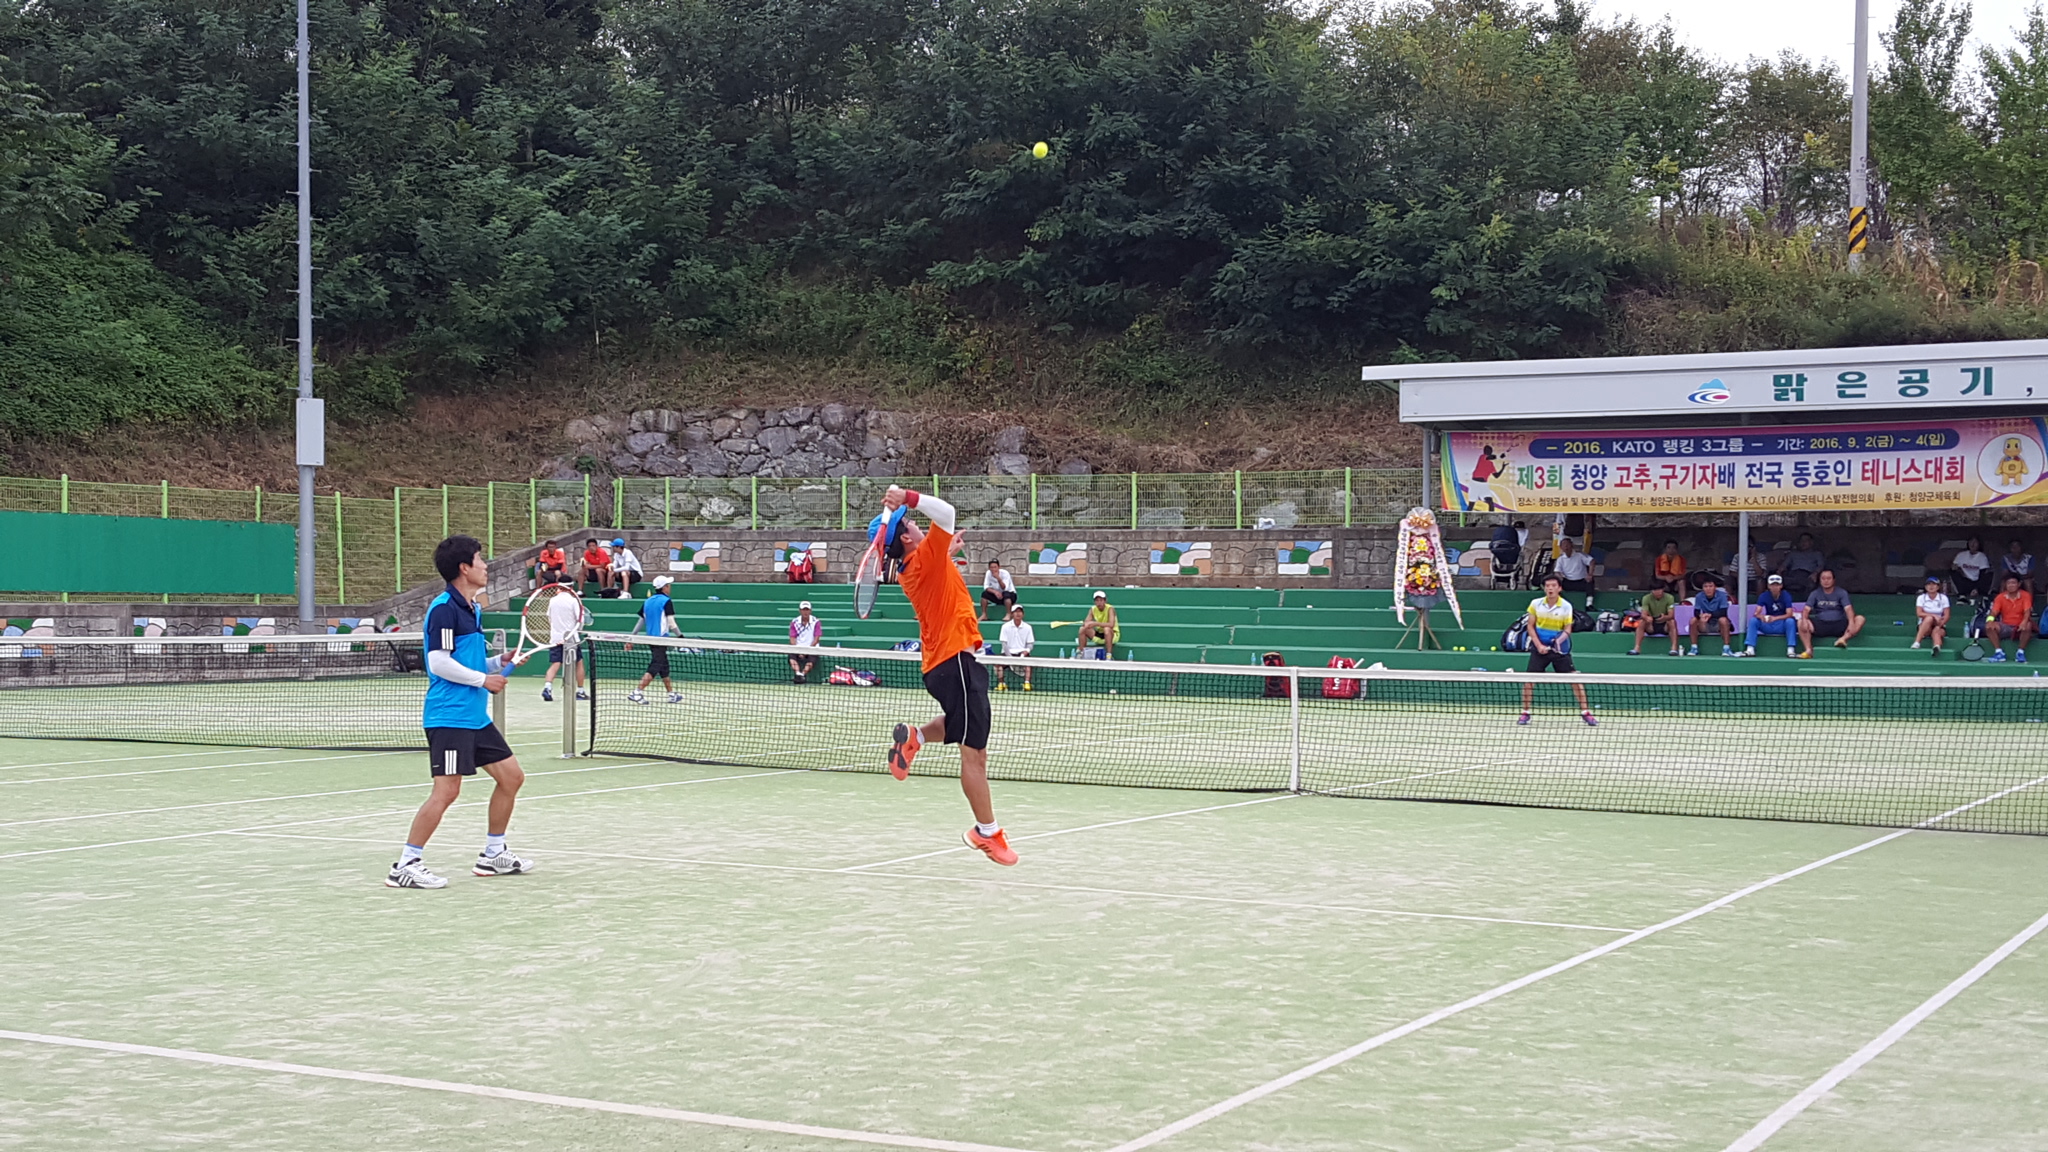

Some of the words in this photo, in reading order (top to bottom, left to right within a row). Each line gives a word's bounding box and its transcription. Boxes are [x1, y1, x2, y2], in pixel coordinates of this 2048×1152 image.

[1563, 441, 1605, 455] 2016.
[1612, 440, 1655, 454] KATO
[1662, 438, 1694, 454] 랭킹
[1701, 437, 1744, 453] 3그룹
[1777, 438, 1804, 451] 기간:
[1810, 436, 1842, 449] 2016.
[1847, 437, 1860, 449] 9.
[1865, 434, 1894, 449] 2(금)
[1916, 433, 1945, 446] 4(일)
[1517, 464, 1563, 490] 제3회
[1571, 463, 1607, 490] 청양
[1614, 462, 1735, 491] 고추,구기자배
[1745, 461, 1784, 489] 전국
[1792, 459, 1852, 488] 동호인
[1861, 455, 1965, 486] 테니스대회
[1517, 497, 1535, 507] 장소:
[1571, 497, 1579, 507] 및
[1581, 497, 1619, 507] 보조경기장
[1627, 496, 1646, 507] 주최:
[1650, 496, 1712, 507] 청양군테니스협회
[1721, 495, 1741, 507] 주관:
[1884, 493, 1905, 504] 후원:
[1909, 491, 1961, 502] 청양군체육회
